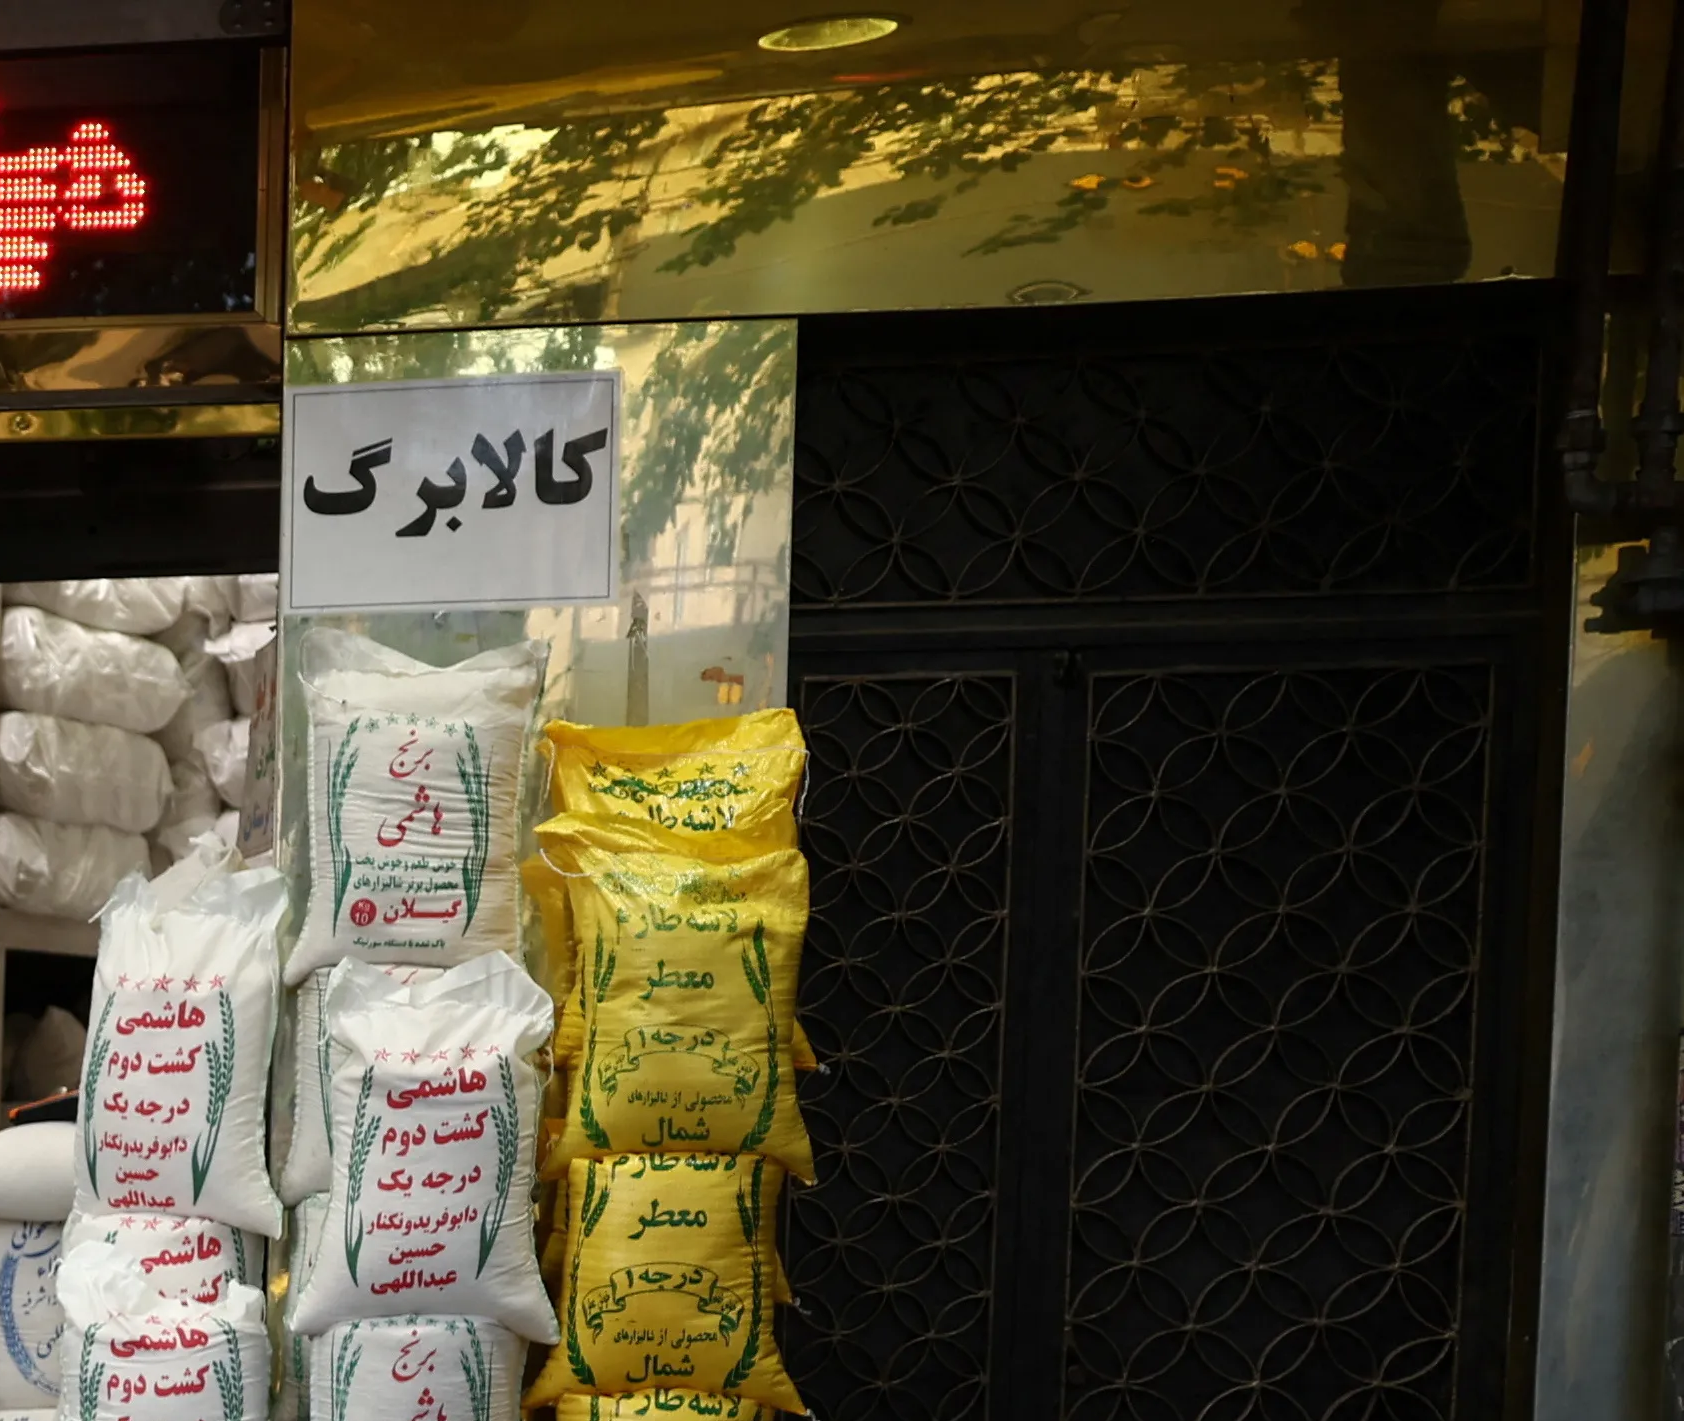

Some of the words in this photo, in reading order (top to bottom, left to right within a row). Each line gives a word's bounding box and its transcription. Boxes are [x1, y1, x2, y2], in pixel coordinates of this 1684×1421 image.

[303, 427, 608, 538] کالابرگ
[389, 728, 433, 778] برنج
[377, 785, 443, 847] هاشمی
[116, 999, 206, 1035] هاشمی
[108, 1051, 141, 1080] دوم
[147, 1045, 202, 1075] کشت
[387, 1066, 487, 1109] هاشمی
[103, 1092, 128, 1123] یک
[134, 1096, 190, 1123] درجه
[382, 1123, 426, 1156] دوم
[433, 1109, 488, 1145] کشت
[377, 1168, 413, 1197] یک
[422, 1165, 481, 1194] درجه
[629, 1199, 707, 1240] معطر
[388, 1243, 446, 1264] حسین
[371, 1269, 457, 1295] عبداللهی
[639, 1268, 704, 1291] درجه
[392, 1330, 437, 1382] برنج
[627, 1353, 696, 1384] شمال
